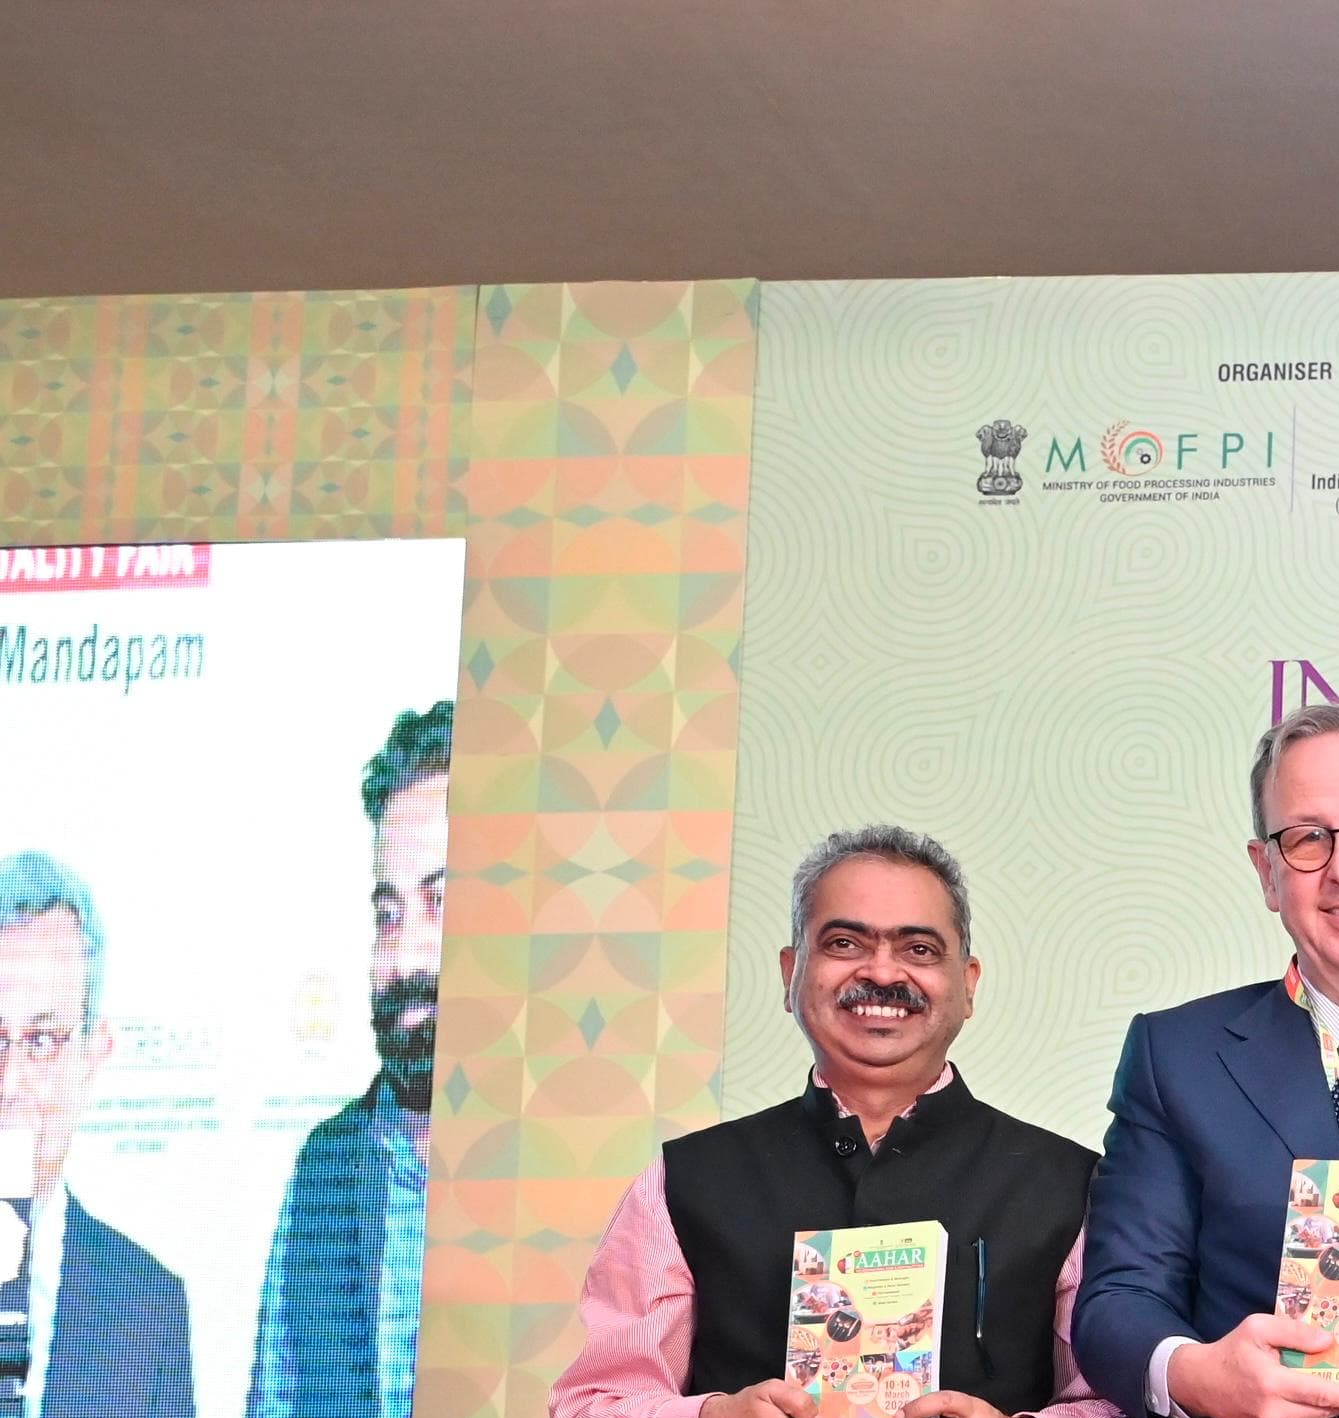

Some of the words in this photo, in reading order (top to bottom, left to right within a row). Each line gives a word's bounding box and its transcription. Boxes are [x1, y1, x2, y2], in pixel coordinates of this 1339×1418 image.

[1218, 362, 1332, 384] ORGANISER
[1042, 481, 1092, 491] MINISTRY
[1096, 481, 1110, 490] OF
[1113, 480, 1140, 489] FOOD
[1144, 479, 1210, 488] PROCESSING
[1213, 477, 1276, 487] INDUSTRIES
[1100, 492, 1171, 502] GOVERNMENT
[1175, 492, 1188, 500] OF
[1192, 491, 1220, 500] INDIA
[0, 624, 205, 696] Mandapam
[855, 1248, 923, 1268] AAHAR
[885, 1401, 909, 1410] 202
